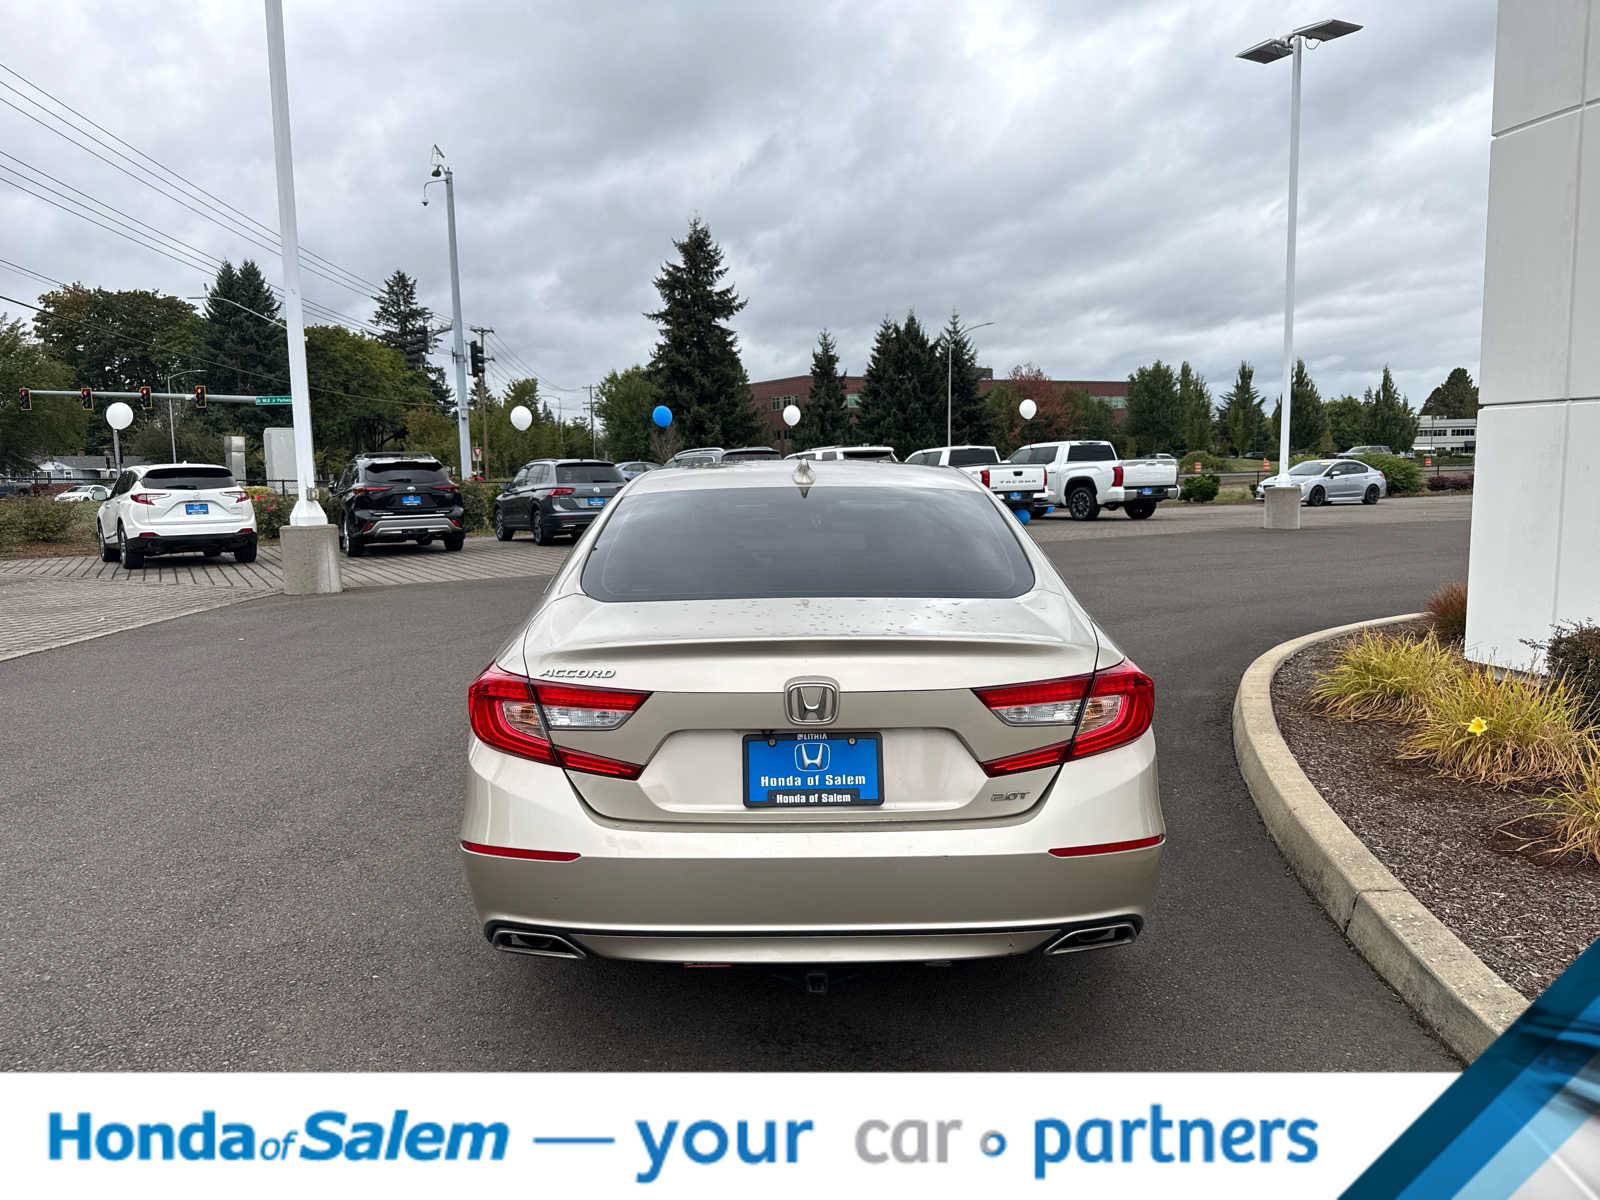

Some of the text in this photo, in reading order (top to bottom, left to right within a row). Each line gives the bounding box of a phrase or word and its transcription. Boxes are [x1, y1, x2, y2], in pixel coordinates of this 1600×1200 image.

[539, 667, 617, 679] ACCORD
[760, 774, 866, 787] Honda of Salem
[776, 793, 851, 804] Honda of Salem
